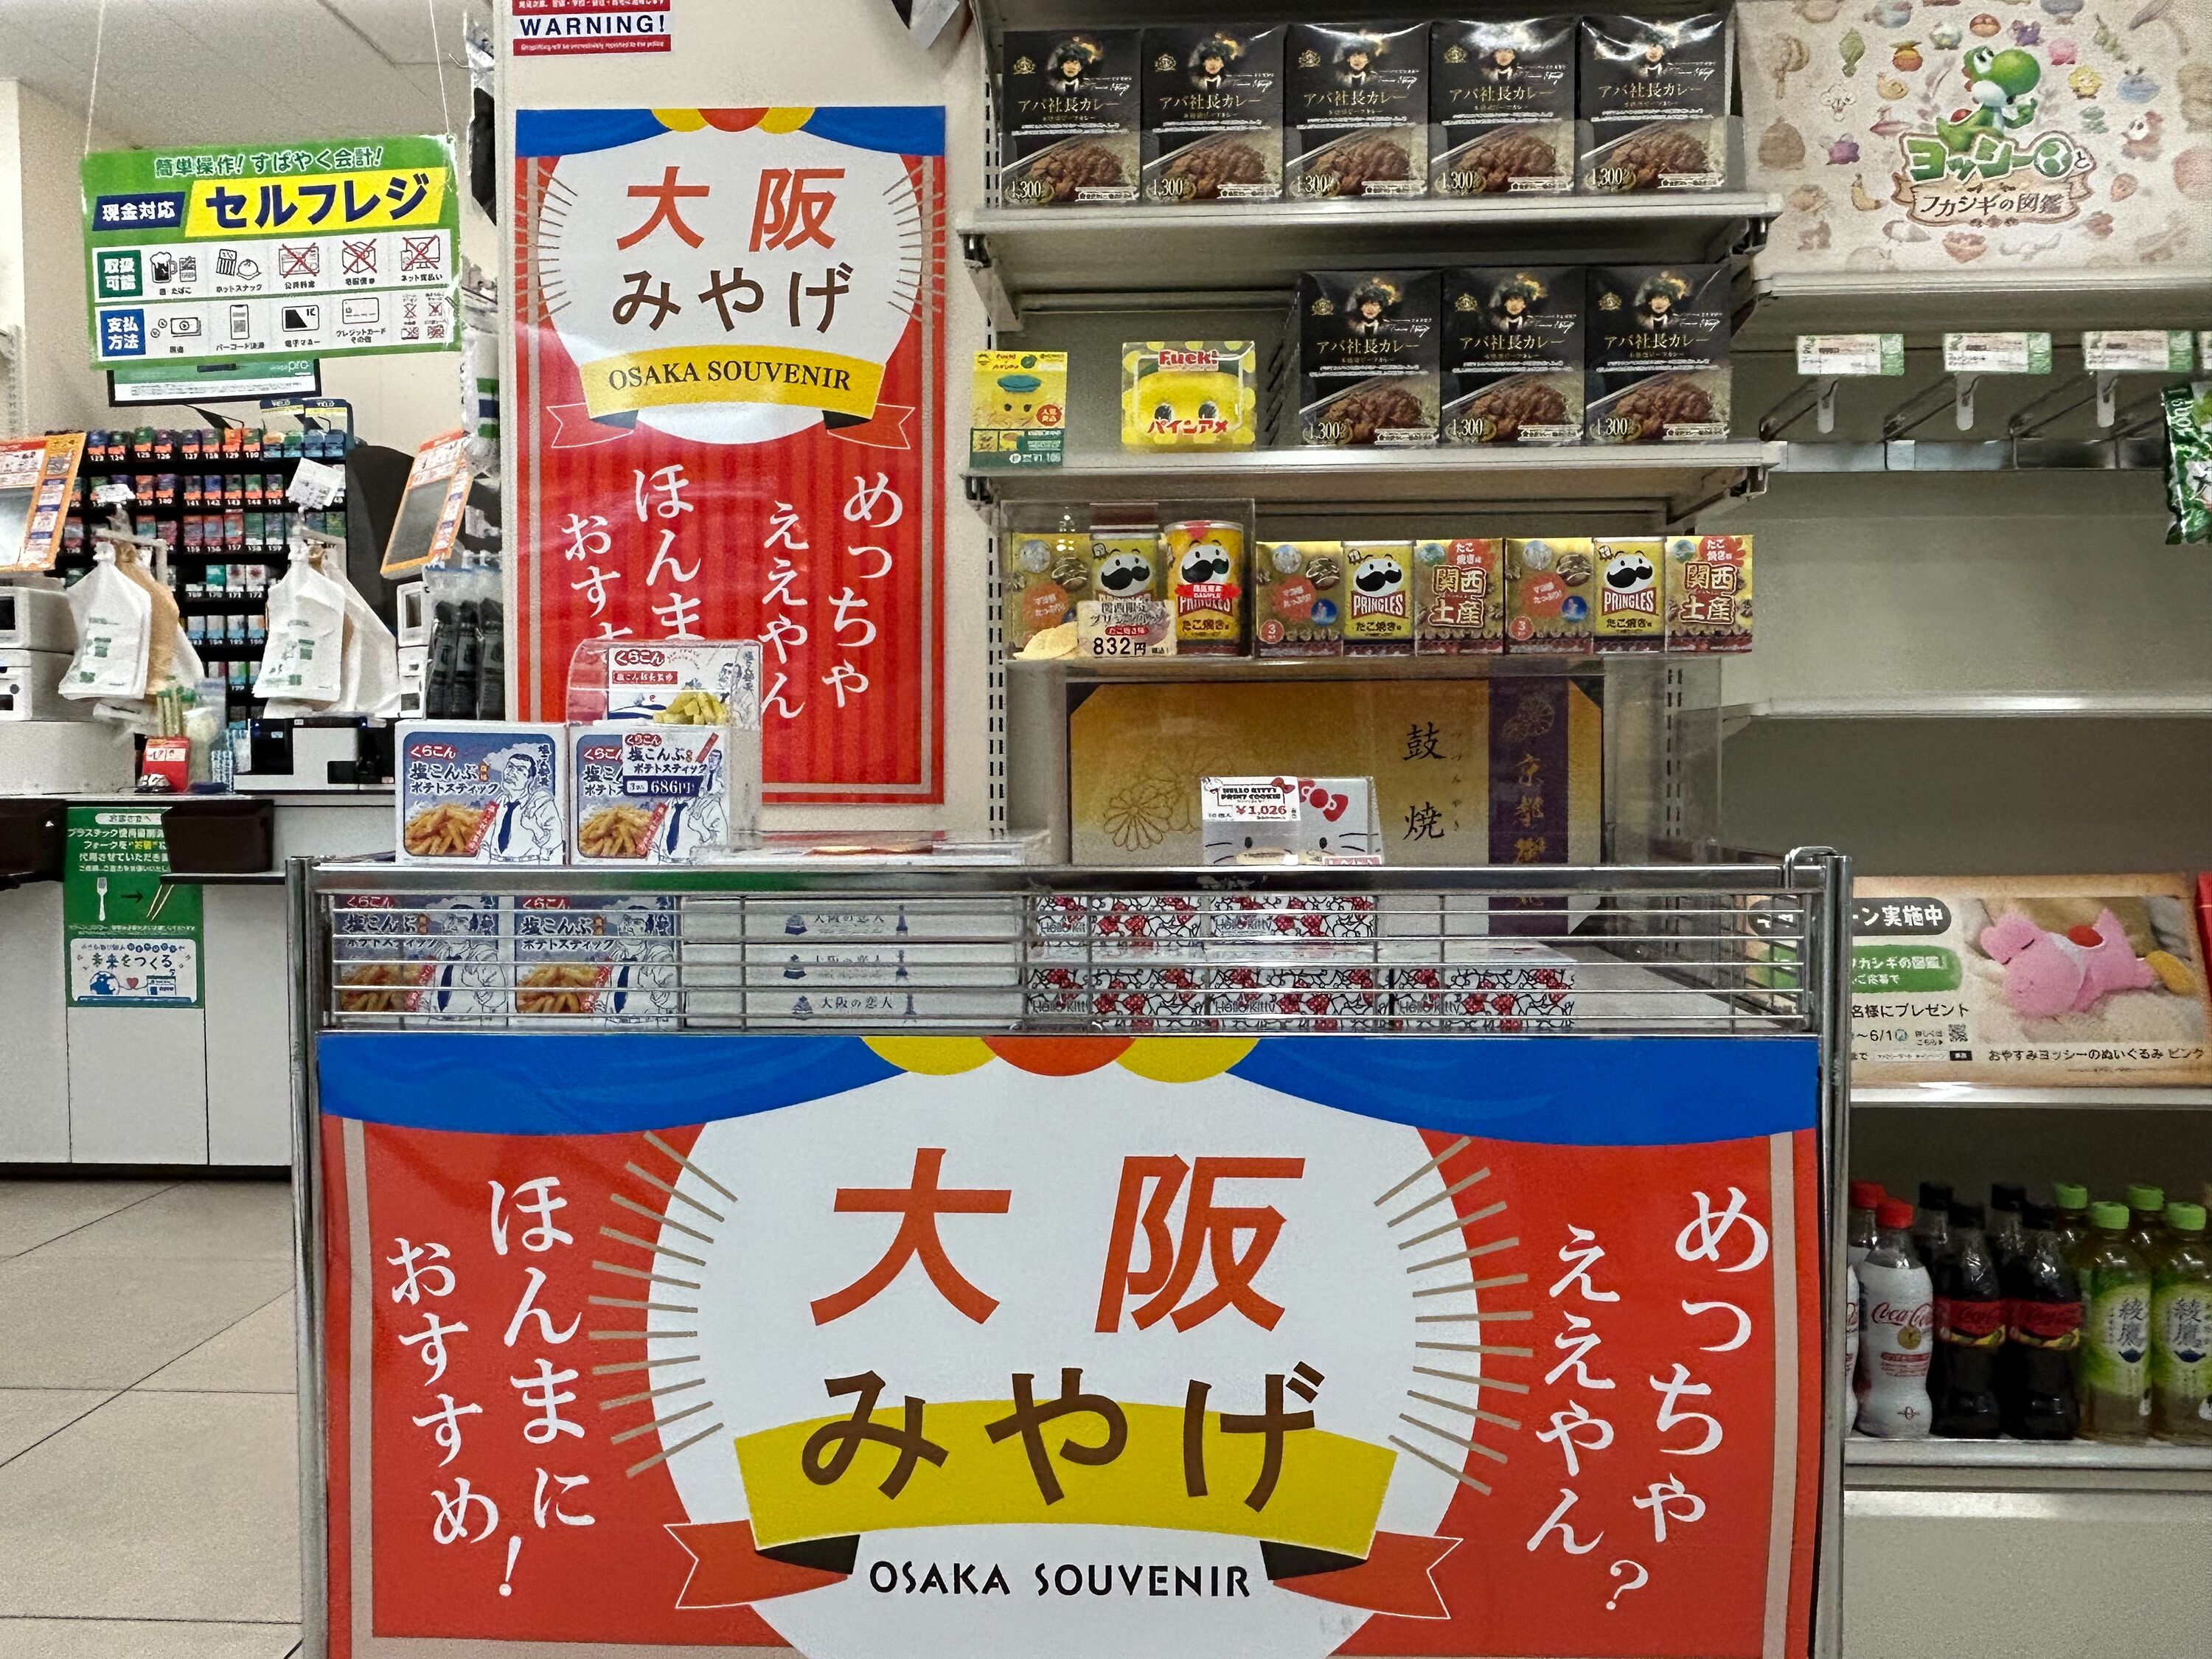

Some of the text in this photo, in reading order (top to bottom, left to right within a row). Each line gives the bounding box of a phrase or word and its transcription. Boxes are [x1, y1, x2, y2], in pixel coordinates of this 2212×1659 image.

[520, 15, 664, 35] WARNING!
[1304, 90, 1410, 106] アパ社長カレー
[1450, 86, 1555, 102] アパ社長カレー
[1598, 83, 1703, 99] アパ社長カレー
[1018, 97, 1121, 113] アパ社長カレー
[1159, 93, 1262, 111] アパ社長カレー
[205, 173, 428, 229] セルフレジ
[616, 166, 845, 251] 大阪
[102, 201, 176, 221] 現金対応
[613, 262, 854, 333] みやげ
[107, 317, 139, 333] 支払
[108, 335, 139, 350] 方法
[1316, 338, 1419, 354] アパ社長カレー
[1460, 334, 1565, 350] アパ社長カレー
[1604, 334, 1710, 349] アパ社長カレー
[609, 360, 850, 390] OSAKA SOUVENIR
[1455, 543, 1474, 552] たこ
[1706, 539, 1725, 549] たこ
[1436, 568, 1484, 593] 関西
[1686, 565, 1734, 589] 関西
[822, 473, 902, 707] めっちゃ
[759, 501, 809, 718] ええやん
[1352, 594, 1405, 616] PRINGLES
[1603, 590, 1655, 613] PRINGLES
[1682, 597, 1733, 621] 土産
[1432, 599, 1481, 623] 土産
[1093, 637, 1146, 655] 832円
[615, 650, 664, 665] くらこん
[627, 734, 661, 746] くらこん
[410, 745, 456, 759] くらこん
[627, 748, 684, 761] 塩こんぶ
[409, 762, 478, 780] 塩こんぶ
[634, 764, 707, 774] ポテトスティック
[410, 782, 500, 795] ポテトスティック
[651, 780, 691, 794] 686円
[1236, 804, 1287, 815] ¥1,026
[347, 896, 394, 908] くらこん
[523, 897, 570, 909] くらこん
[521, 916, 593, 935] 塩こんぶ
[92, 953, 173, 970] 未来をつくる
[821, 996, 892, 1009] 大阪の恋人
[810, 1147, 1305, 1333] 大阪
[488, 1176, 595, 1527] ほんまに
[1632, 1187, 1769, 1542] めっちゃ
[801, 1360, 1325, 1512] みやげ
[870, 1562, 1251, 1597] OSAKA SOUVENIR
